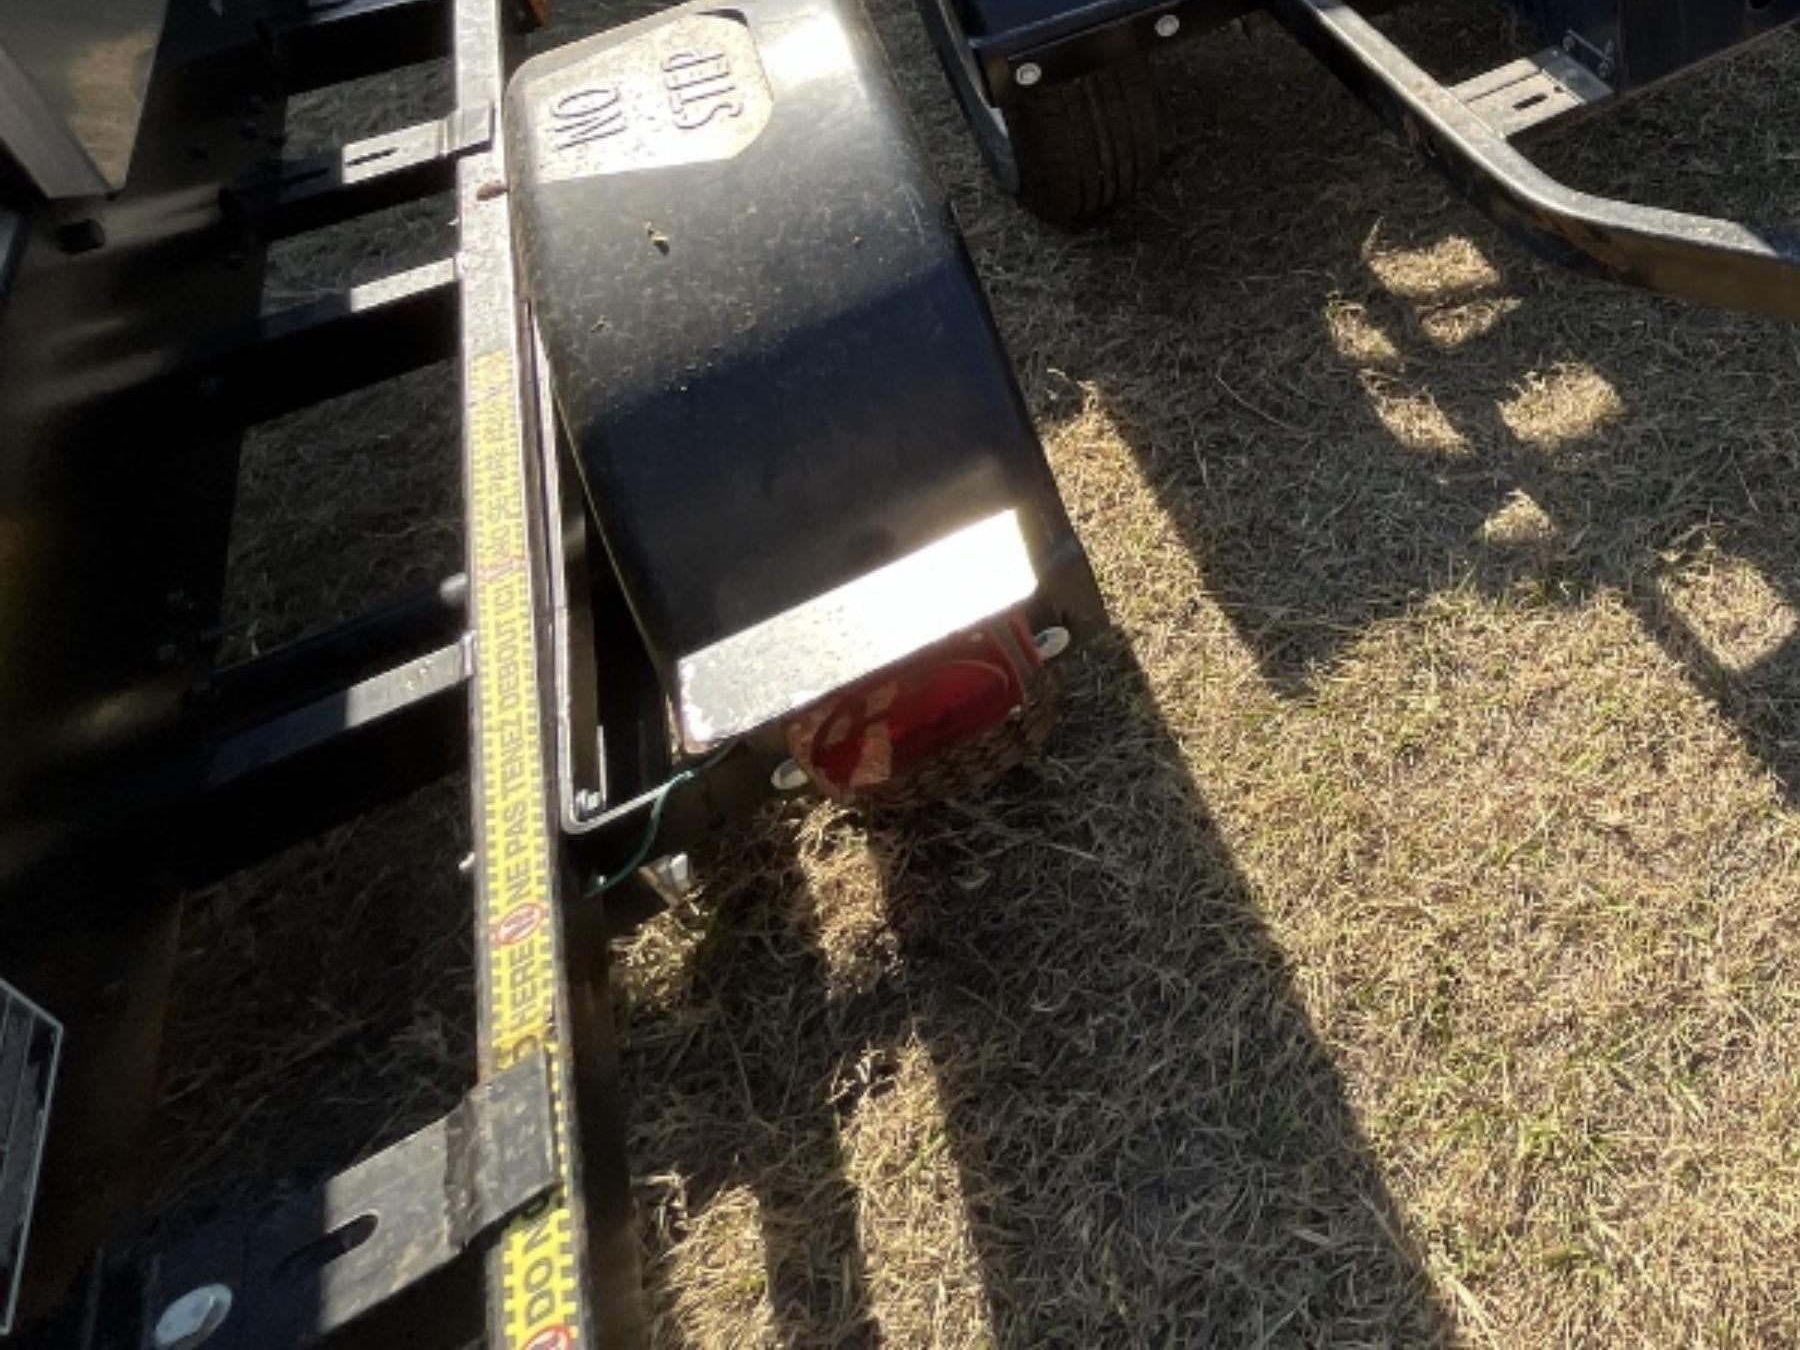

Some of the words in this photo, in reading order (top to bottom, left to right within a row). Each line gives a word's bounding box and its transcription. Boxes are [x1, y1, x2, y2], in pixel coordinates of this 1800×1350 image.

[549, 88, 628, 150] NO
[660, 52, 745, 130] STEP
[496, 618, 521, 714] DEBOUT
[500, 710, 527, 801] TENEZ
[503, 800, 529, 859] PAS
[506, 857, 532, 907] NE
[509, 938, 539, 1027] HERE
[524, 1256, 556, 1327] DO
